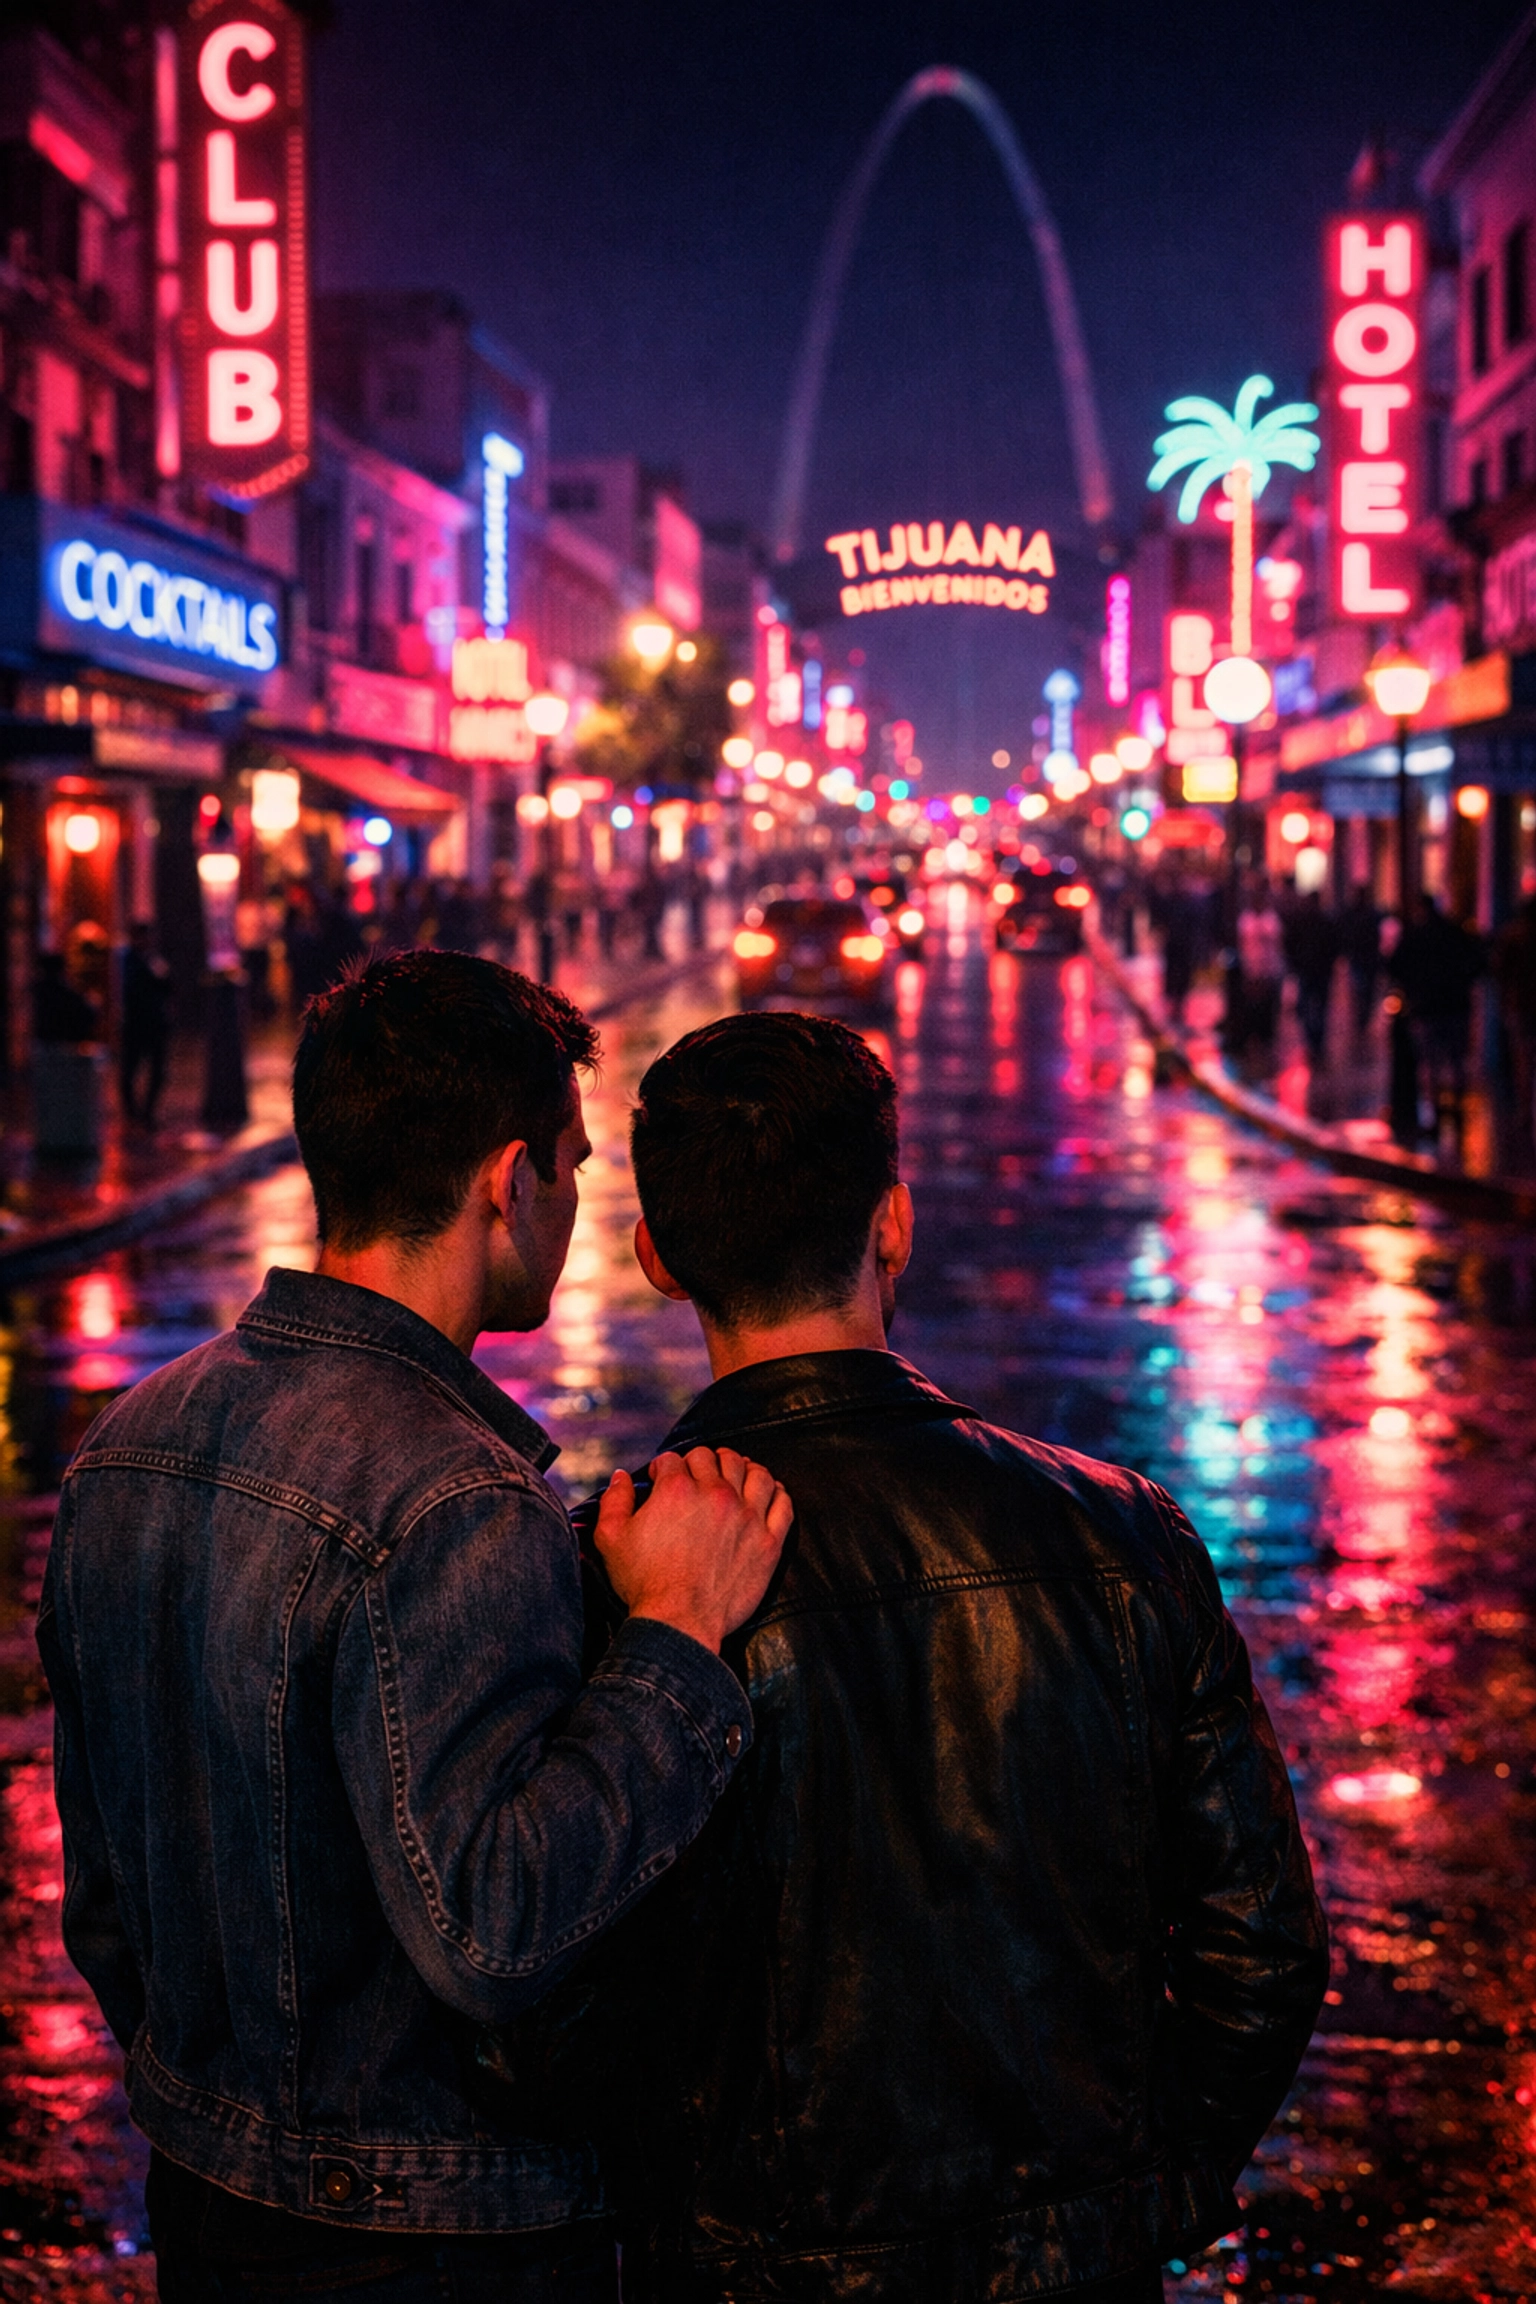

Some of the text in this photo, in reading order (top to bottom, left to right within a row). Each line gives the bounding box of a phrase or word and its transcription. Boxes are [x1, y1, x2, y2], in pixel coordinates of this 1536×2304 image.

[199, 21, 282, 446] CLUB
[1334, 223, 1416, 614] HOTEL
[60, 539, 278, 672] COCKTAILS
[826, 521, 1056, 578] TIJUANA
[840, 573, 1049, 616] BIENVENIDOS
